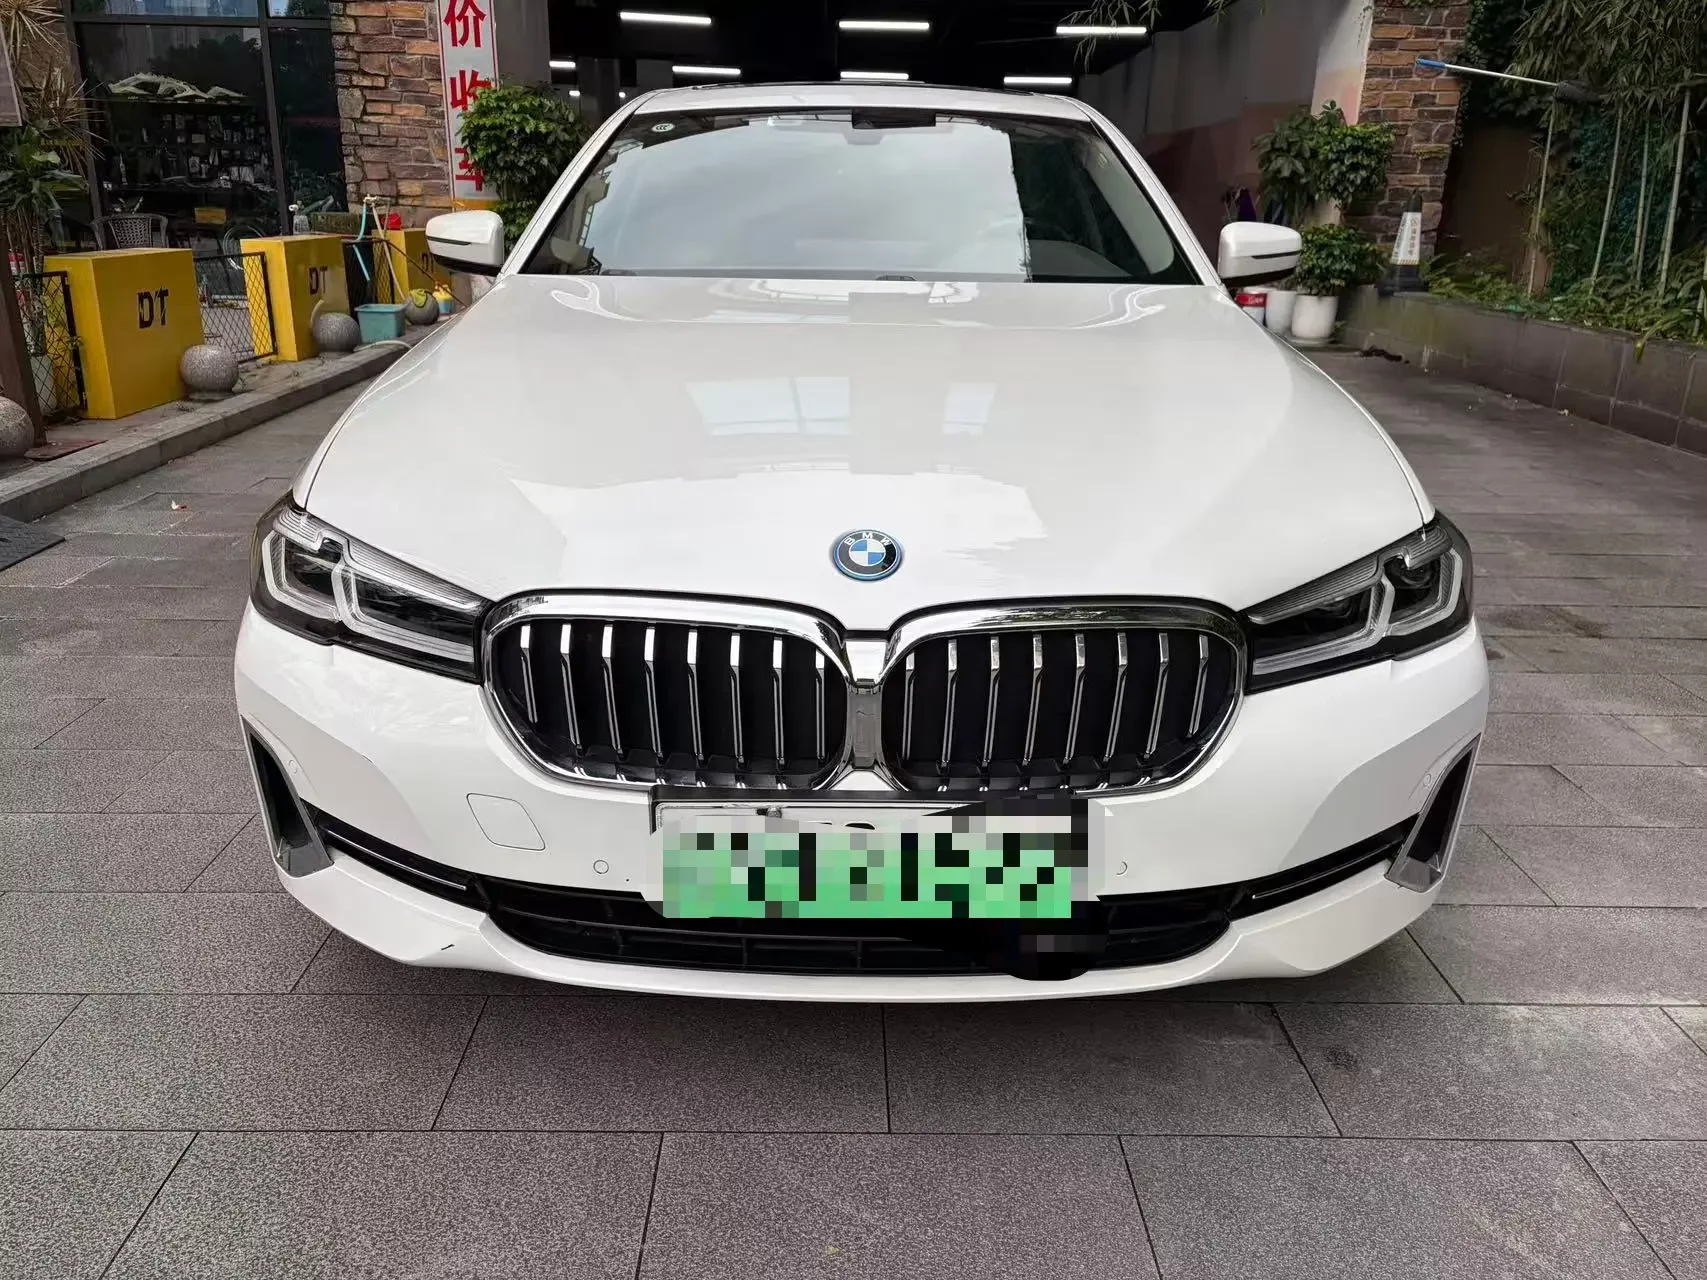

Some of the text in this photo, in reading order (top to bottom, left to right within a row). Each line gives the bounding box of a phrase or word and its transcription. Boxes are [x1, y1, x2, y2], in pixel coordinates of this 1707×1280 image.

[309, 266, 328, 294] DT
[138, 288, 169, 328] DT
[843, 532, 891, 546] BMW
